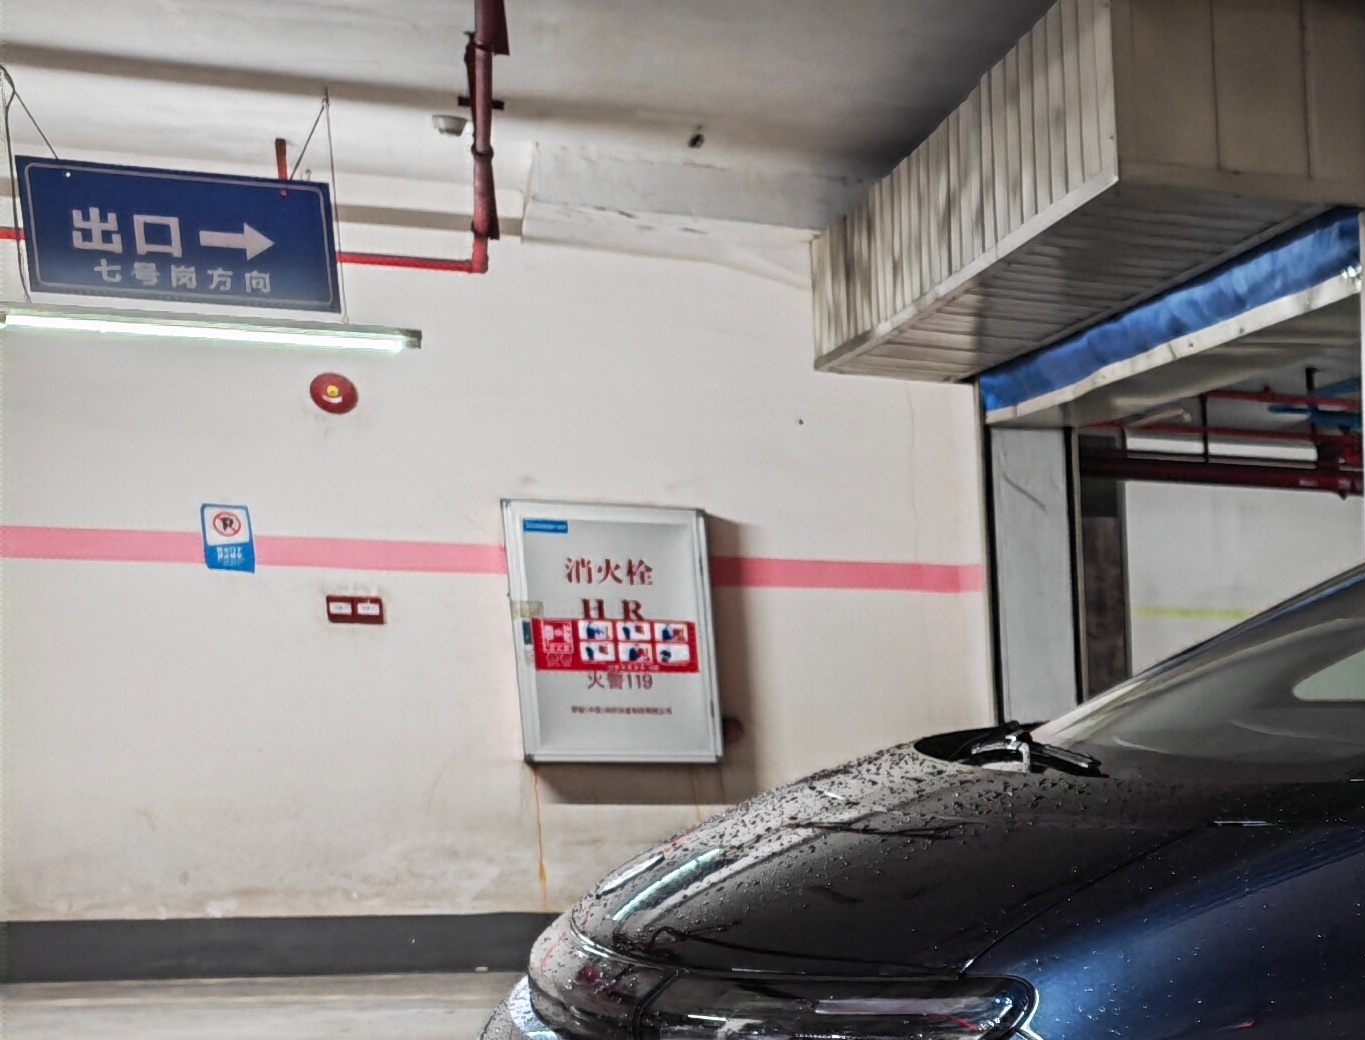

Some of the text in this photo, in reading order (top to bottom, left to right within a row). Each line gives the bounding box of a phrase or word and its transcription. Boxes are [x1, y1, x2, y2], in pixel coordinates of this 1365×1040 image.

[72, 207, 183, 258] 出口
[93, 258, 271, 294] 七号岗方向
[565, 557, 653, 586] 消火栓
[587, 671, 653, 690] 火警119
